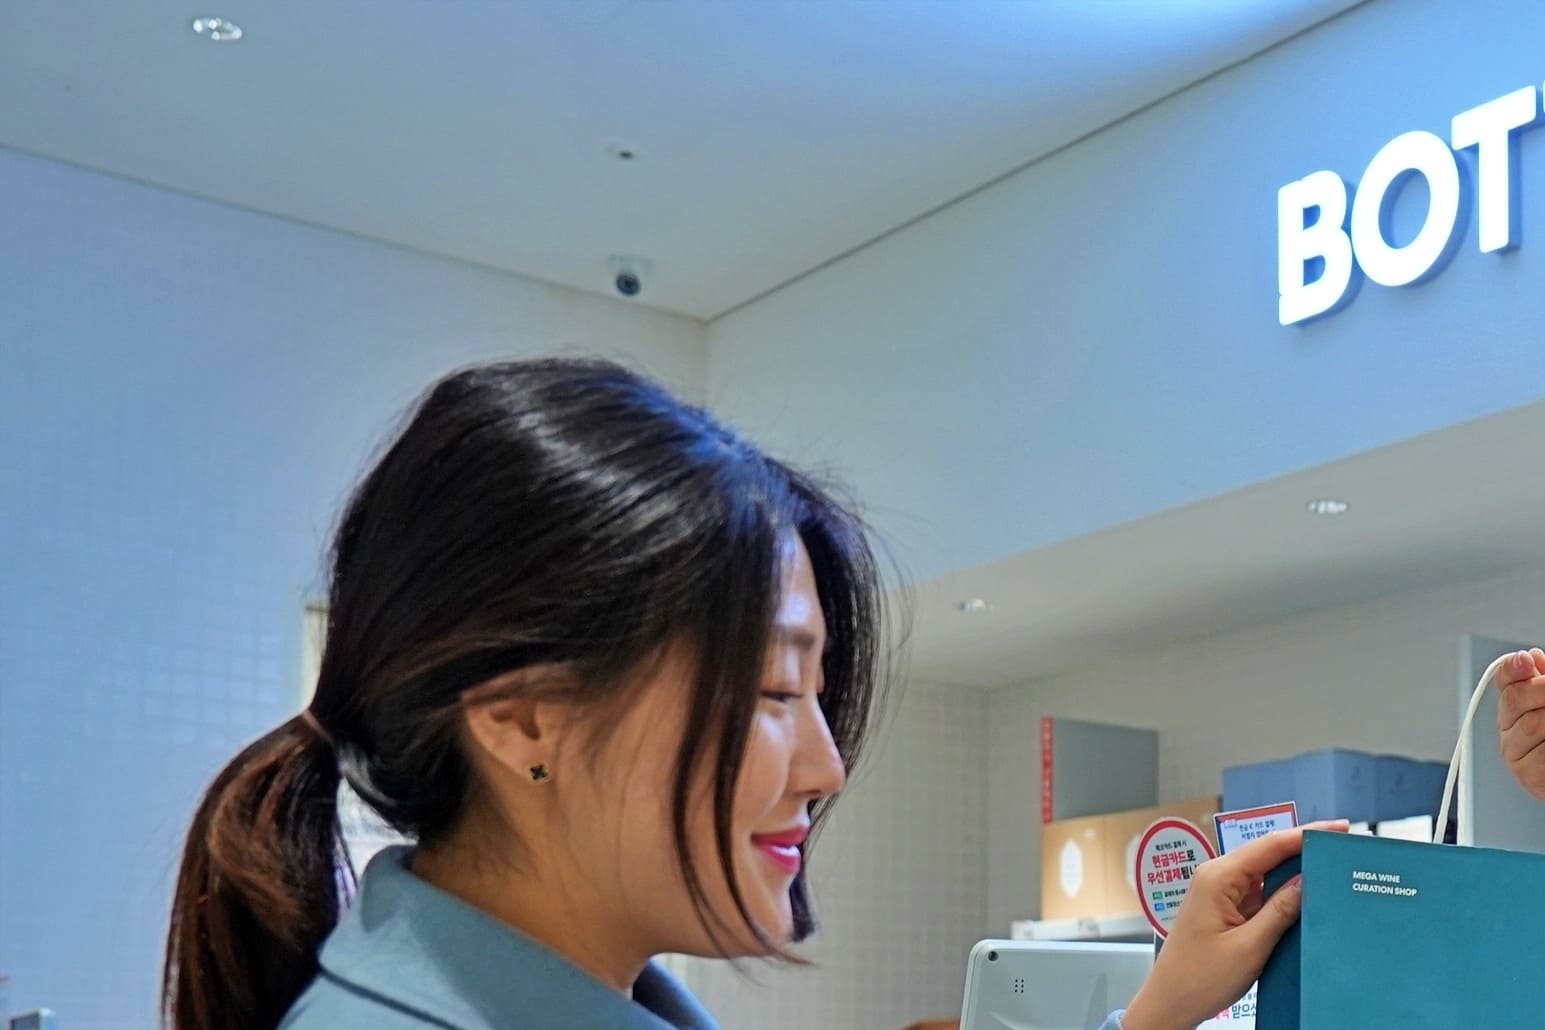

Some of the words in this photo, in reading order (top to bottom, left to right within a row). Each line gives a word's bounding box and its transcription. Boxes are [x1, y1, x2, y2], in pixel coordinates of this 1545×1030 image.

[1152, 849, 1196, 868] 현금카드로
[1352, 871, 1377, 881] MEGA
[1378, 873, 1401, 883] WINE
[1352, 883, 1393, 894] CURATION
[1394, 887, 1417, 897] SHOP
